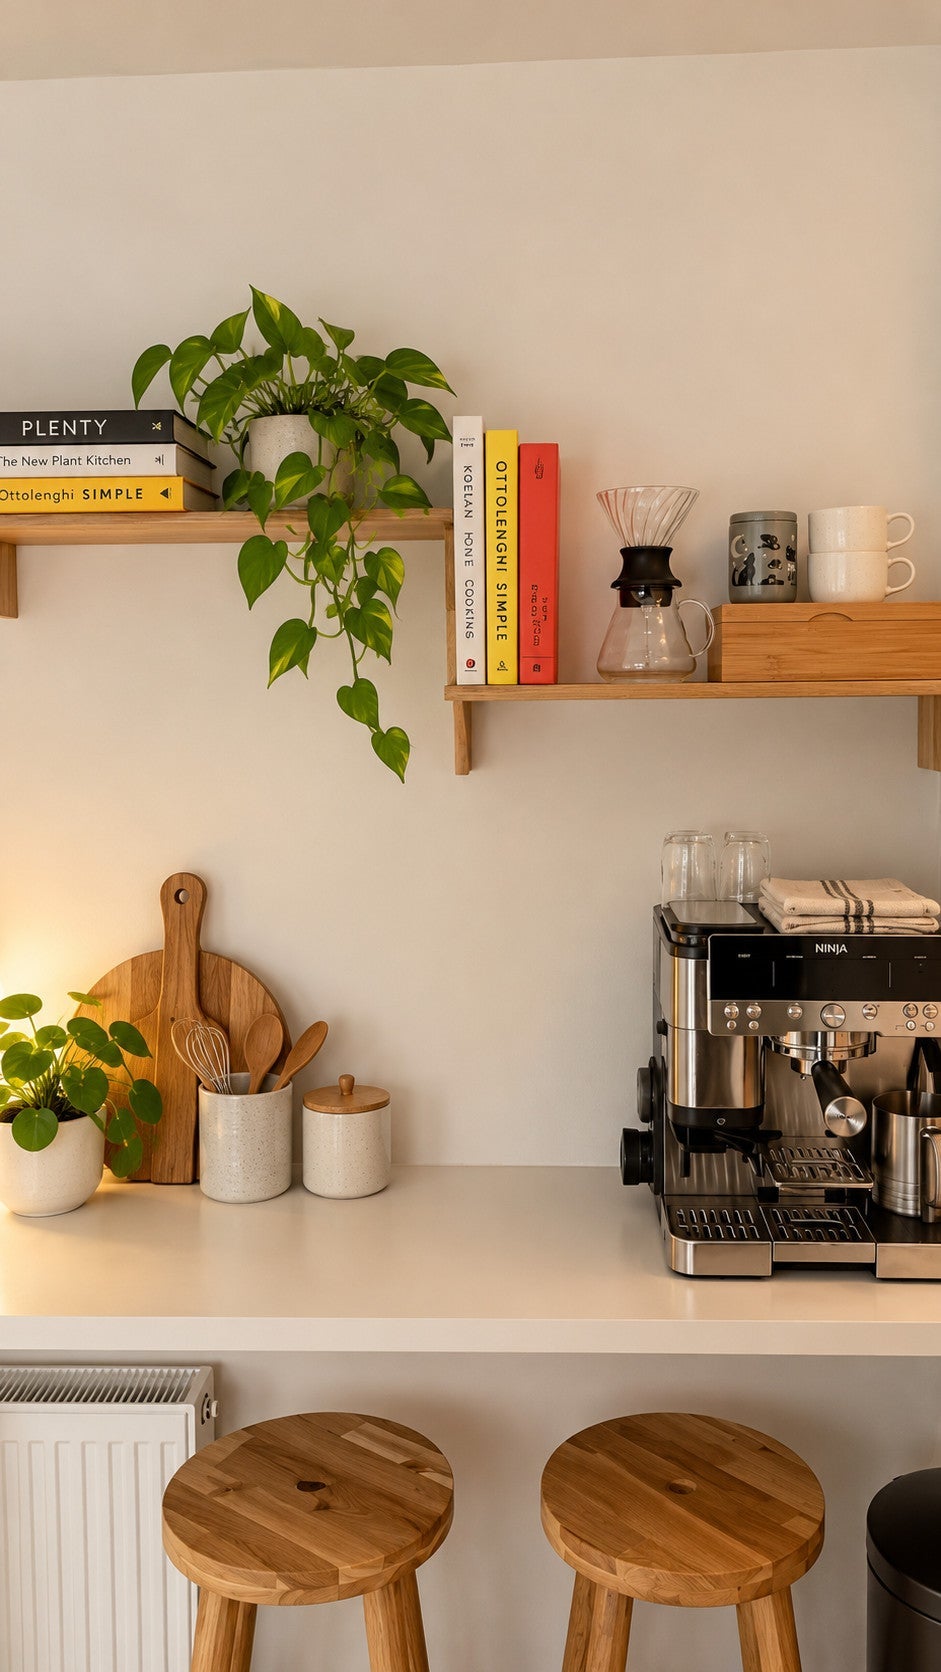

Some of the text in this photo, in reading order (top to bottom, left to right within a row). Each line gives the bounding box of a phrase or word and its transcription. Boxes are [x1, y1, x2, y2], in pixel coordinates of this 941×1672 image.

[22, 419, 108, 437] PLENTY
[21, 455, 49, 467] New
[52, 455, 82, 466] Plant
[86, 454, 131, 466] Kitchen
[0, 487, 144, 504] Ottolenghi SIMPLE
[496, 460, 508, 641] OTTOLENGHI SIMPLE
[815, 943, 848, 955] NINJA
